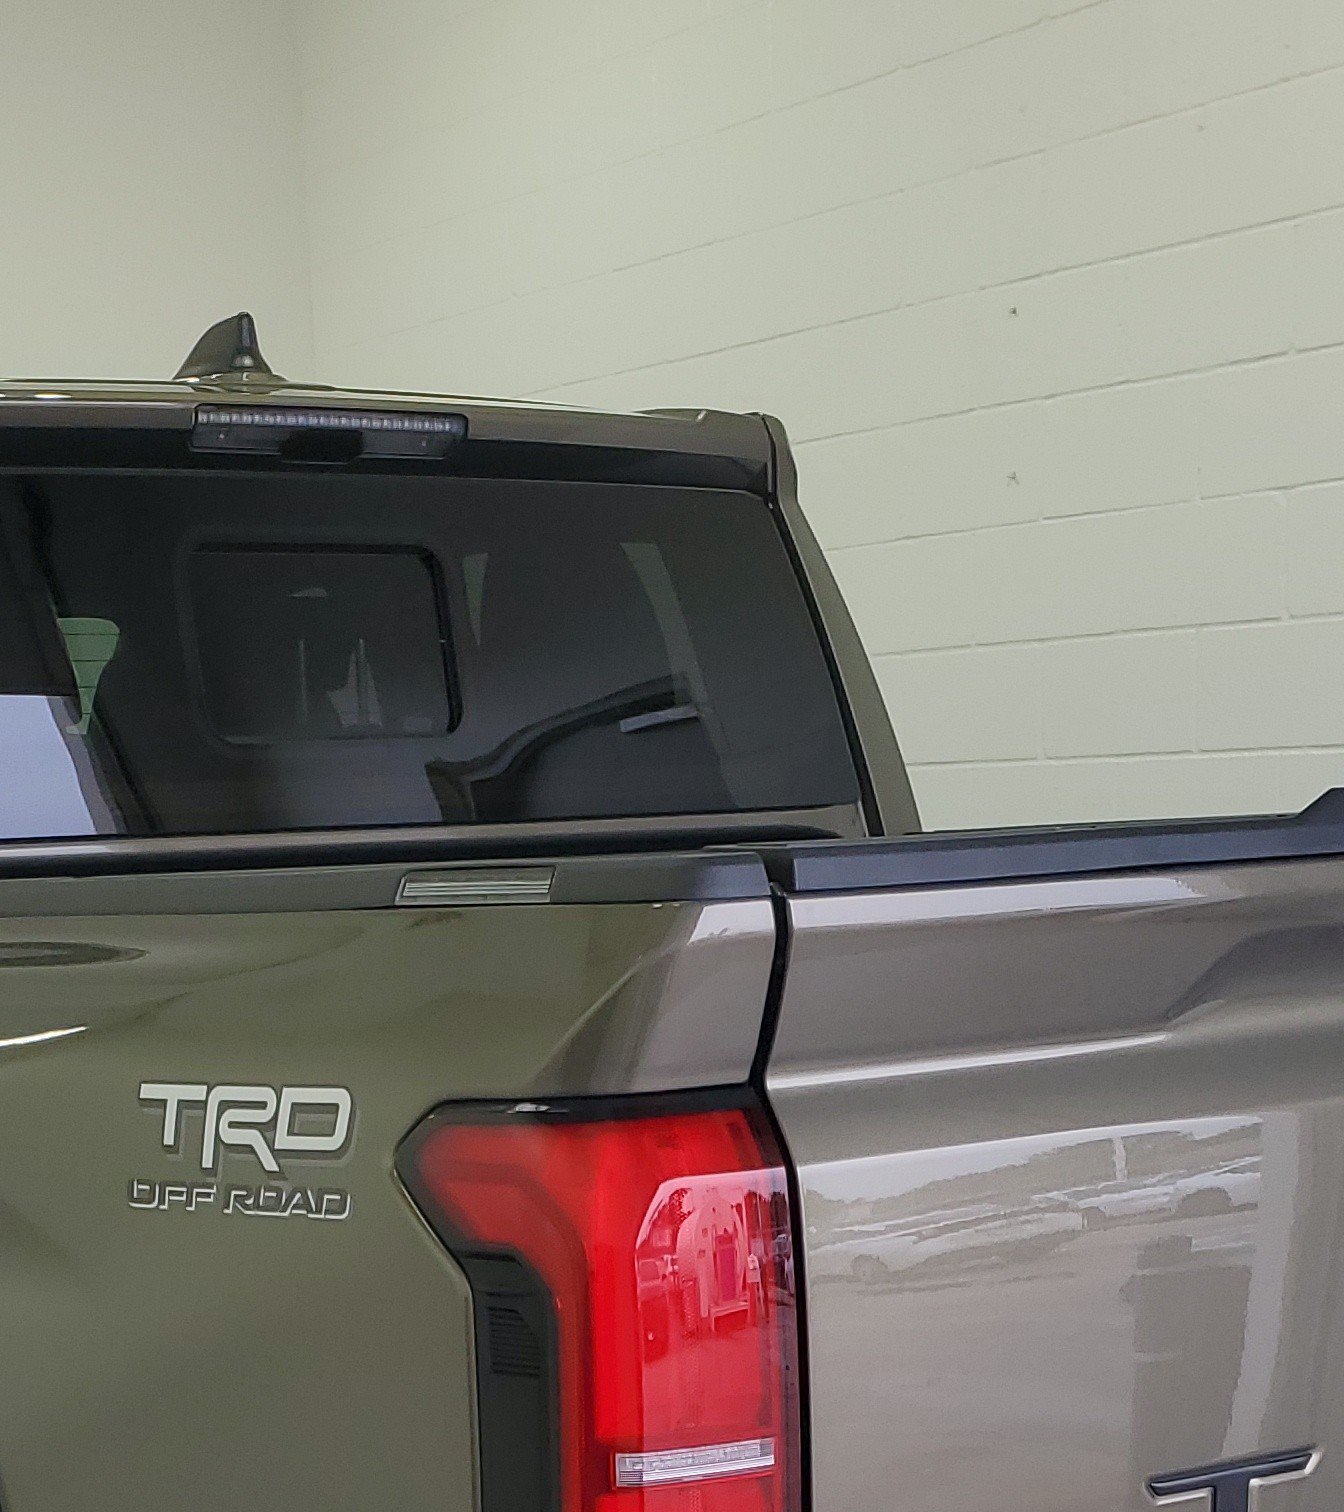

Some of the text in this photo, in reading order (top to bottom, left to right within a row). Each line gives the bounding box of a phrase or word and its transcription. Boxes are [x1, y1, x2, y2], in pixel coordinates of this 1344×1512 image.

[139, 1083, 352, 1172] TRD
[128, 1178, 352, 1220] OFF ROAD
